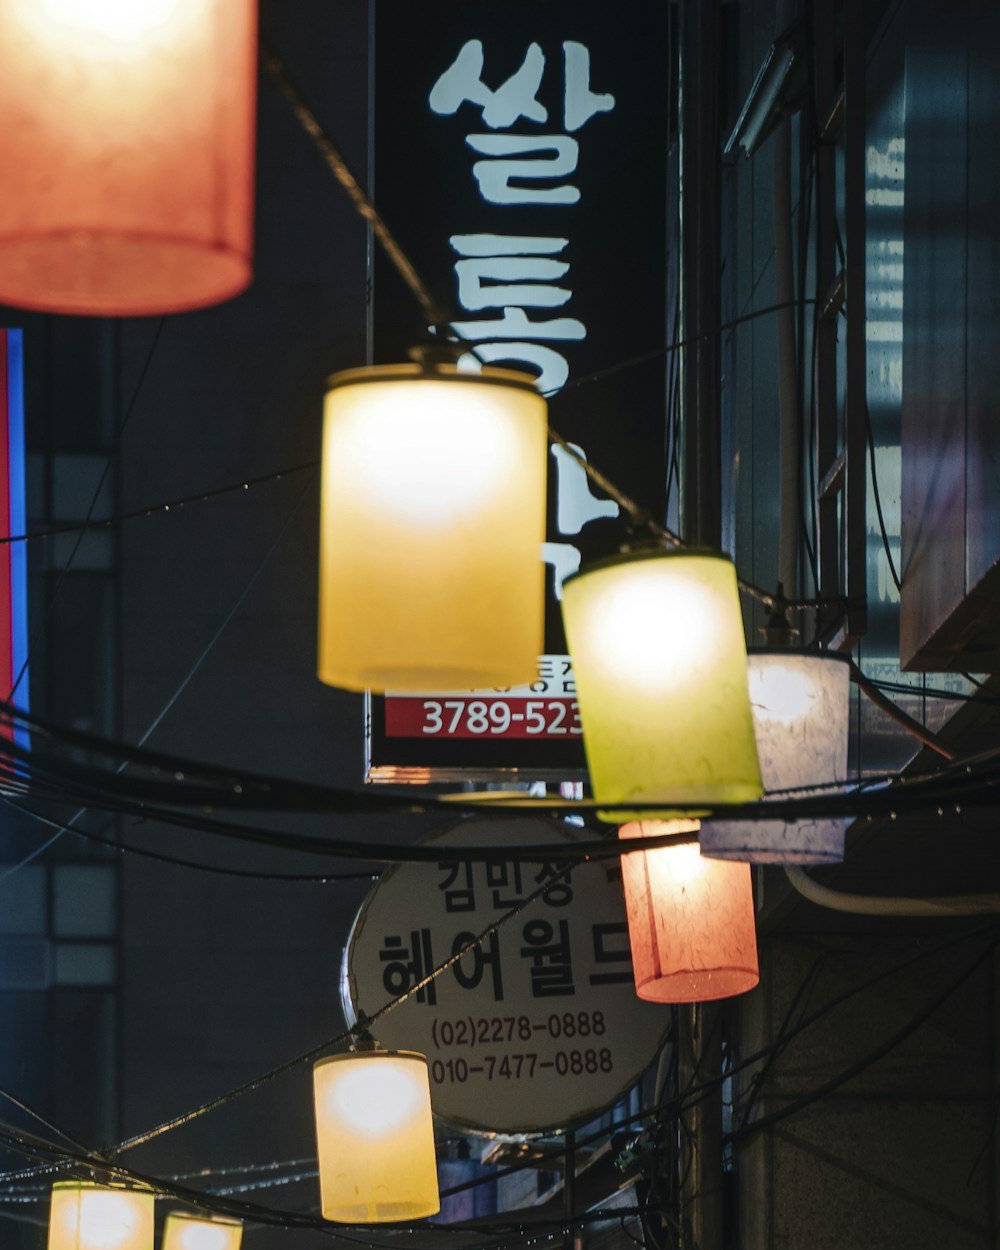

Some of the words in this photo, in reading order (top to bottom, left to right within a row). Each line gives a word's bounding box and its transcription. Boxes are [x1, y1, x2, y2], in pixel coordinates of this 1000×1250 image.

[422, 700, 584, 735] 3789-523
[379, 919, 635, 1006] 헤어월드
[431, 1011, 606, 1048] (02)2278-0888
[431, 1048, 613, 1084] 010-7477-0888
